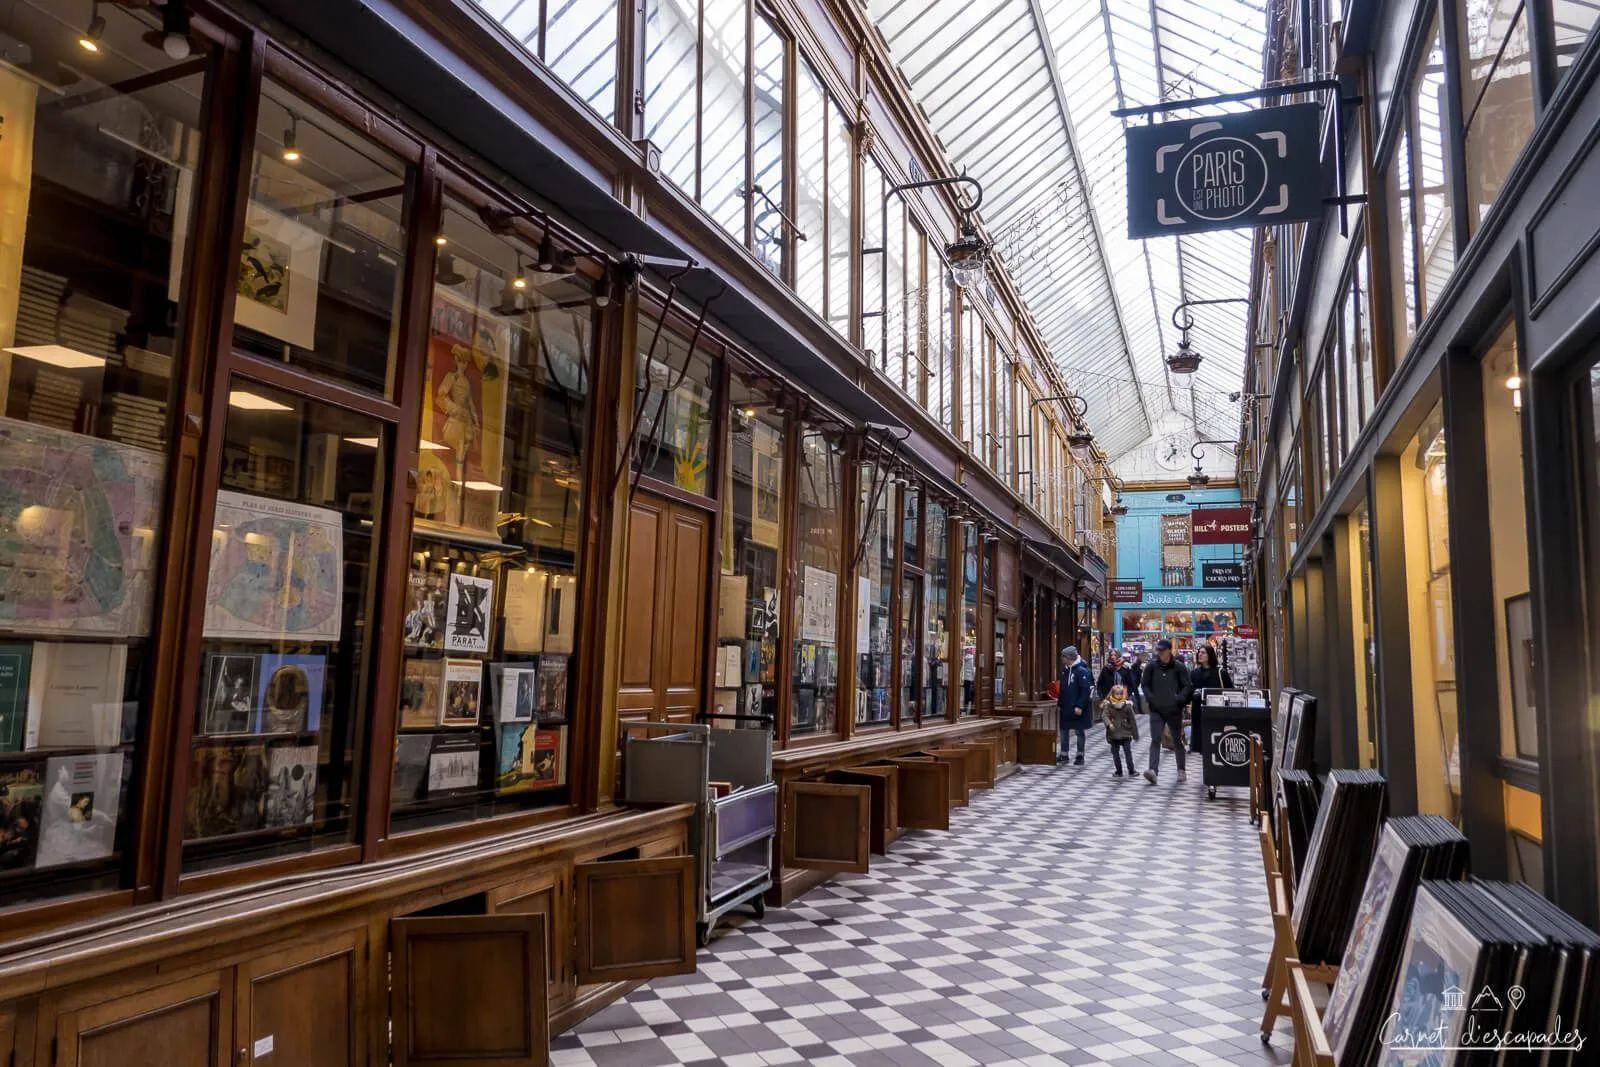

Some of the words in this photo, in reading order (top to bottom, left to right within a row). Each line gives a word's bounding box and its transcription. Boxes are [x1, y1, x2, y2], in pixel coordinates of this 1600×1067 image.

[1193, 149, 1245, 189] PARIS
[1193, 189, 1204, 200] EST
[1206, 185, 1245, 209] PHOTO
[1220, 524, 1249, 532] POSTERS
[452, 636, 477, 645] PARAT
[1225, 737, 1246, 753] PARIS
